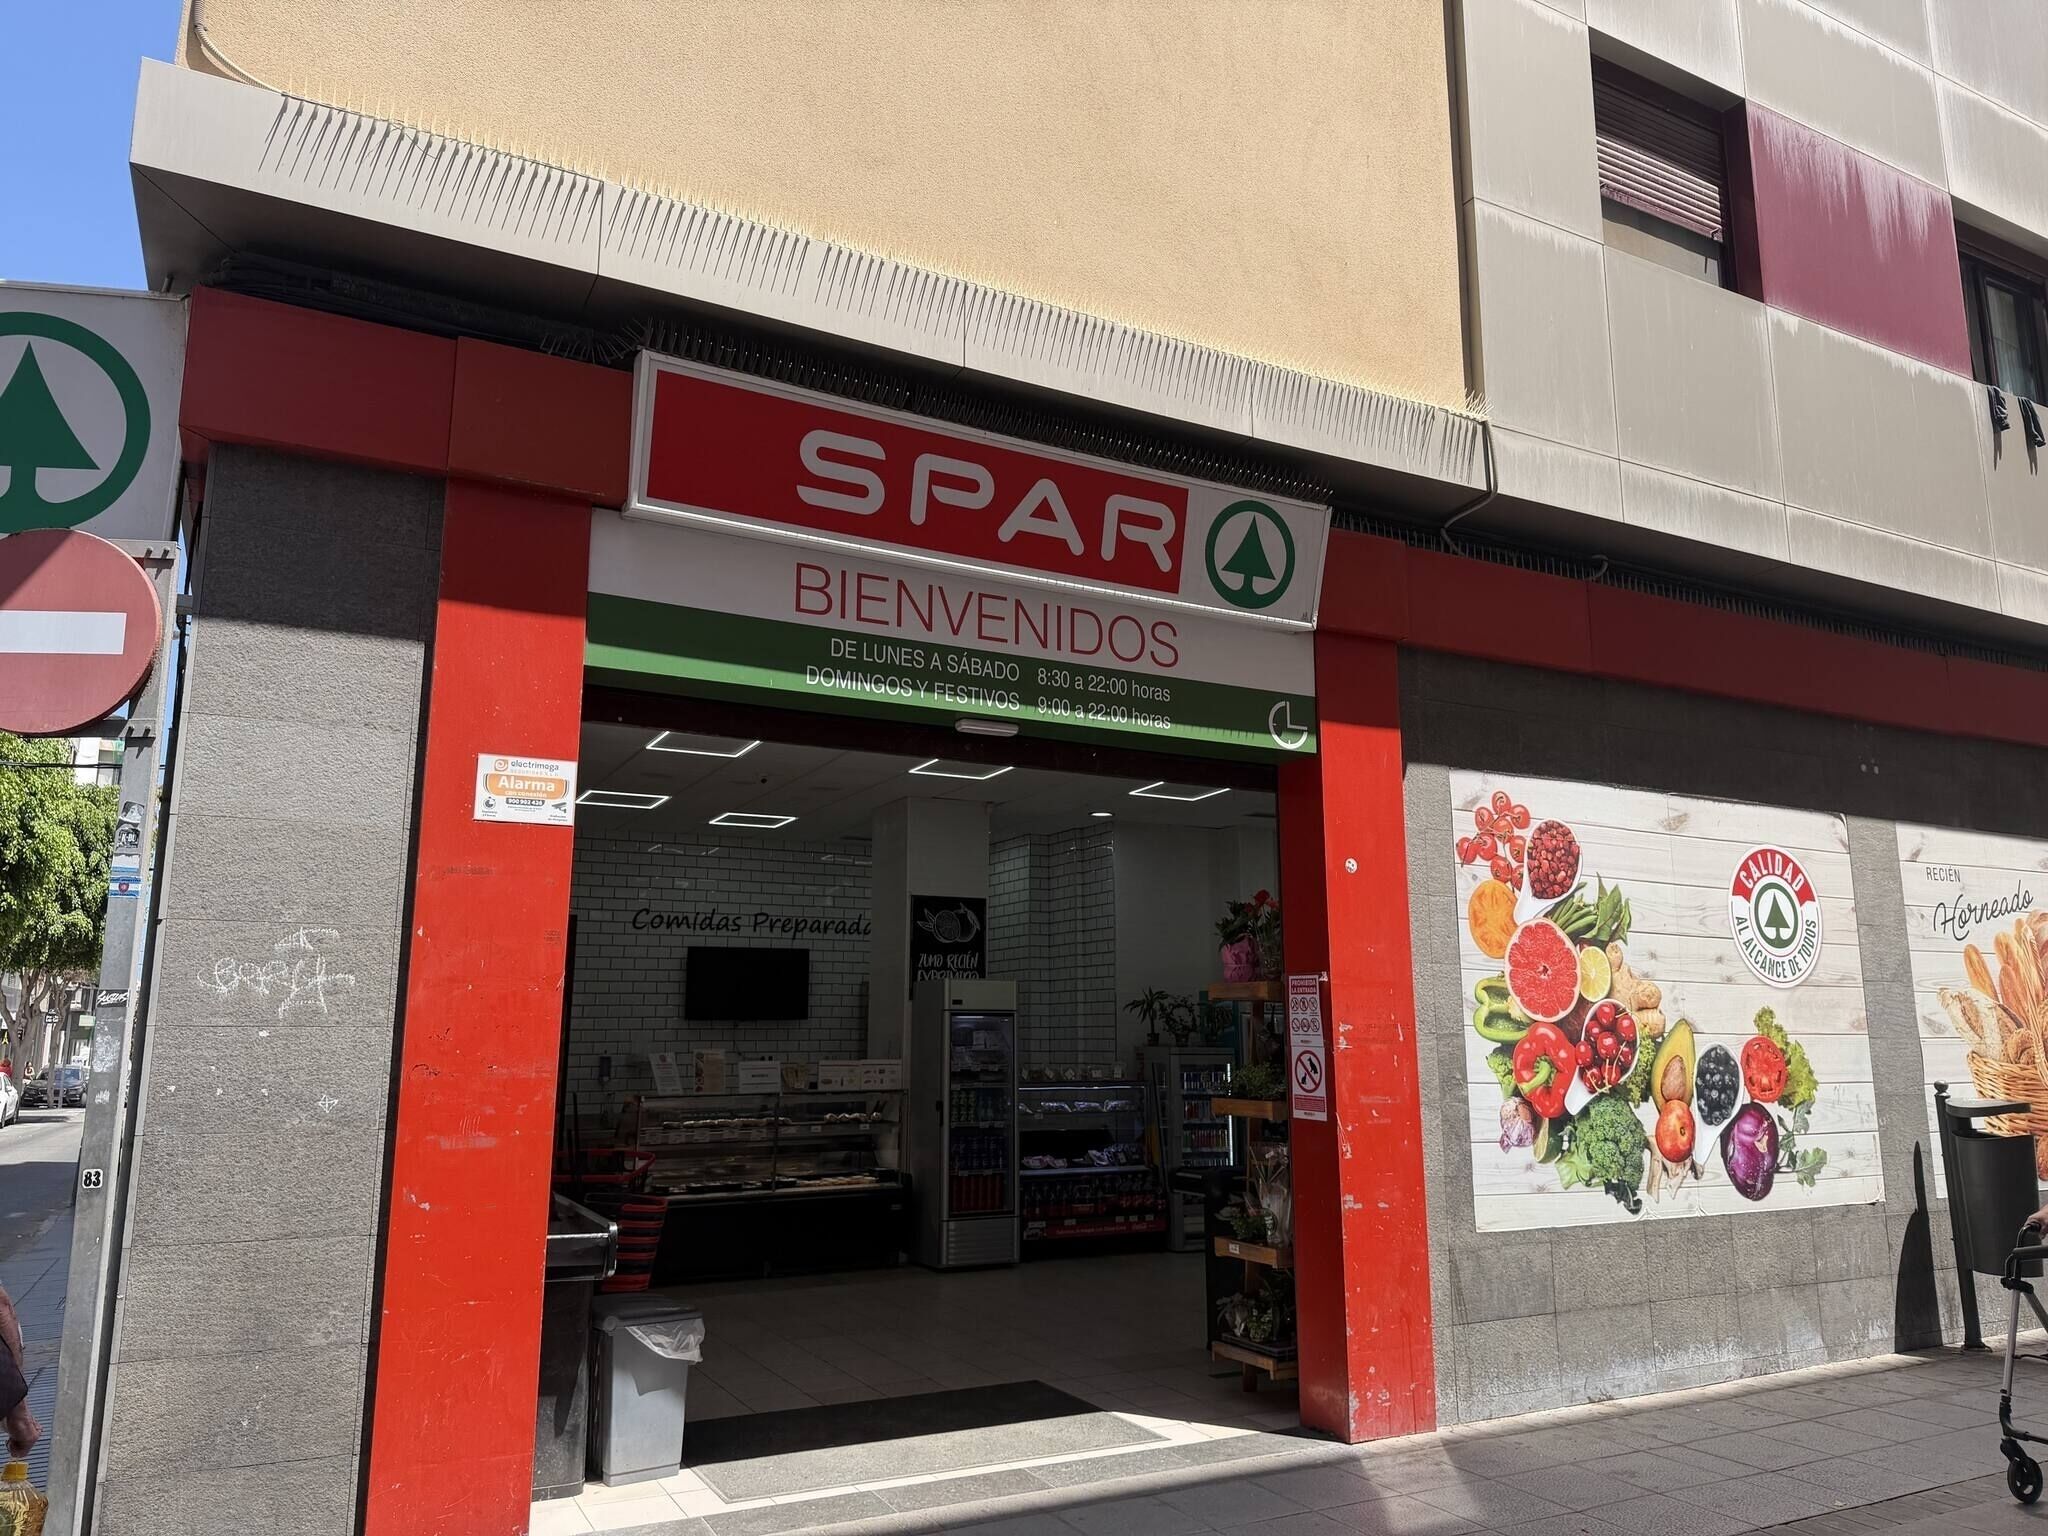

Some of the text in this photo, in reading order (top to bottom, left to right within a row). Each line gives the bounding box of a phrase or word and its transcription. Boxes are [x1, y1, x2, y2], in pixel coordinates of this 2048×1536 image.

[797, 429, 1175, 572] SPAR
[795, 562, 1178, 667] BIENVENIDOS
[831, 637, 1170, 702] DE LUNES A SÁBADO 8:30 a 22:00 horas
[806, 664, 1170, 730] DOMINGOS Y FESTIVOS 9:00 a 22:00 horas
[498, 775, 555, 792] Alarma
[1740, 852, 1805, 892] CALIDAD
[1926, 867, 1961, 883] RECIÉN
[632, 908, 742, 930] Comidas
[1933, 879, 2034, 941] Horneado
[919, 951, 979, 971] ZUMO RECIÉN
[1735, 916, 1817, 978] AL ALCANCE DE TODOS
[84, 1171, 100, 1187] 83
